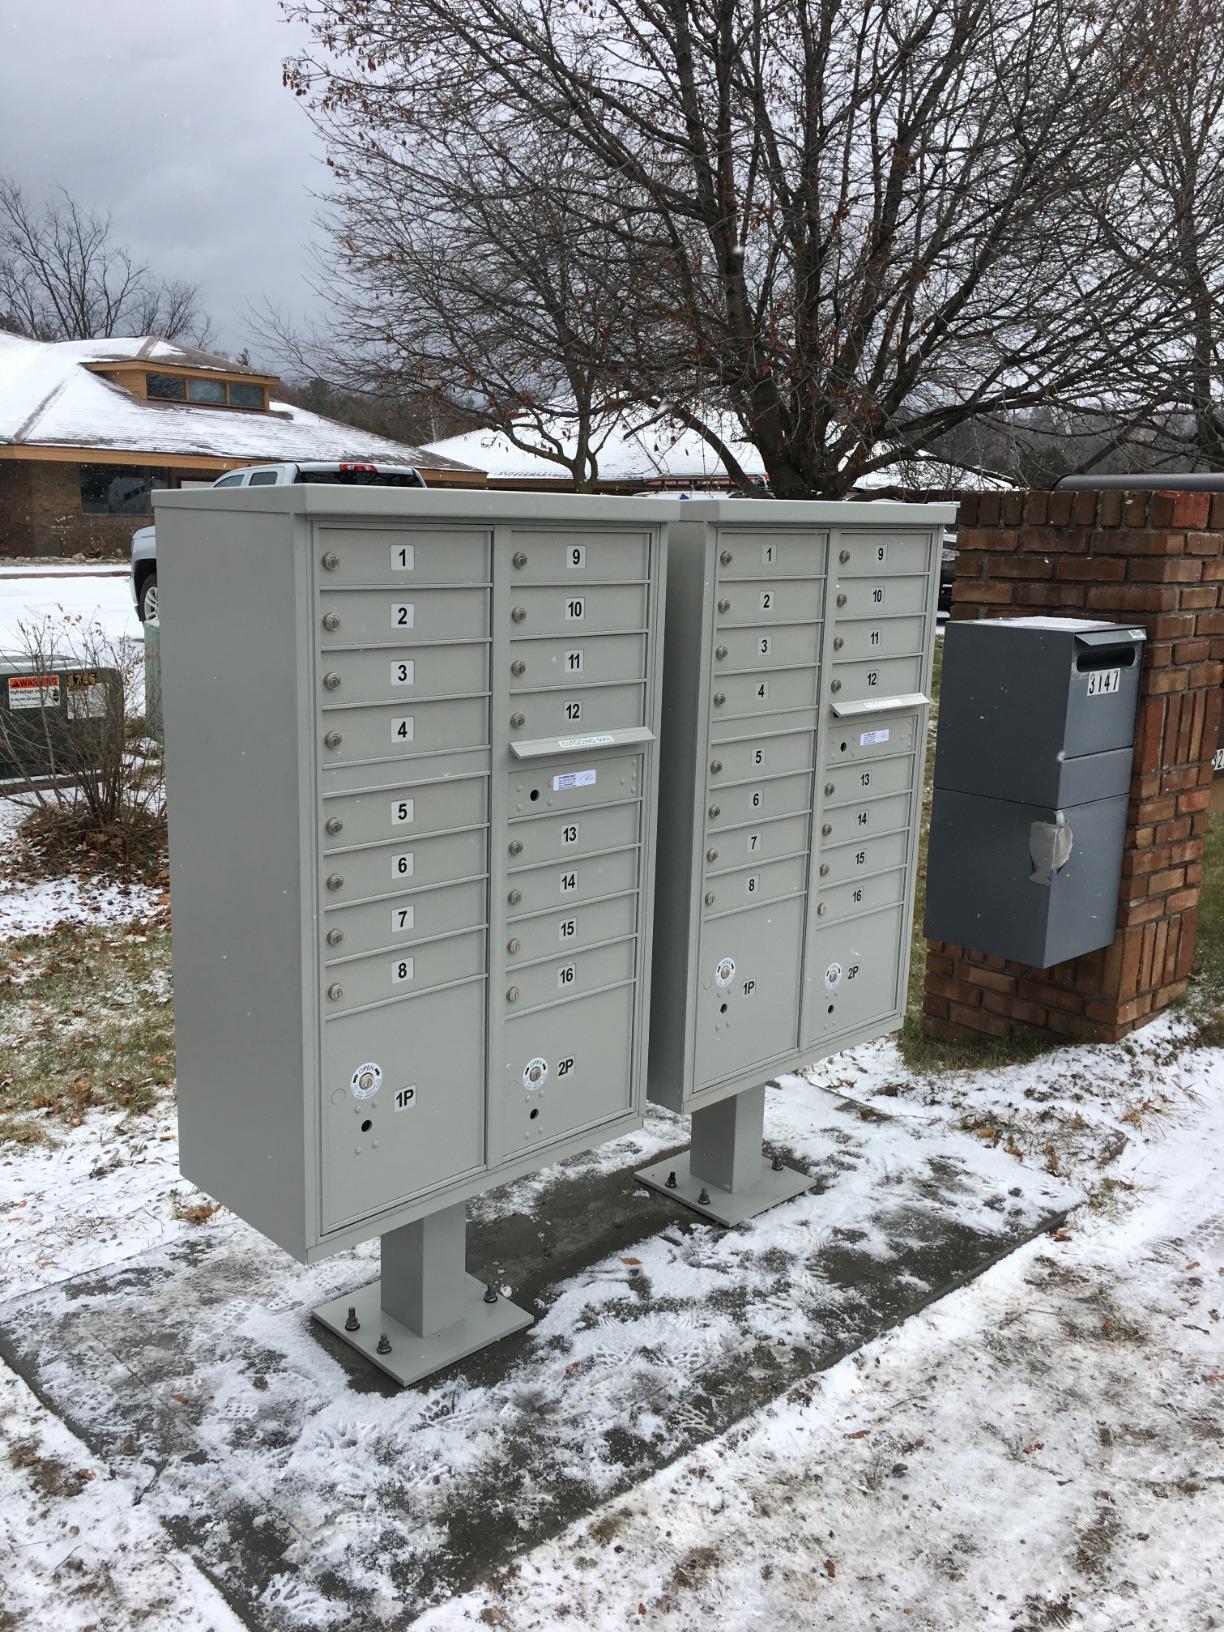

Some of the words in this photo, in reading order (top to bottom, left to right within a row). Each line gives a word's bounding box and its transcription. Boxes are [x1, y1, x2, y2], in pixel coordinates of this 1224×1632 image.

[398, 548, 406, 567] 1
[572, 548, 581, 565] 9
[878, 547, 884, 561] 9
[763, 594, 770, 609] 2
[872, 589, 883, 603] 10
[397, 607, 408, 625] 2
[568, 601, 583, 617] 10
[761, 639, 768, 653] 3
[869, 631, 879, 645] 11
[567, 653, 580, 670] 11
[398, 664, 408, 682] 3
[867, 672, 877, 686] 12
[1088, 671, 1119, 694] 3147
[757, 684, 765, 698] 4
[565, 703, 580, 720] 12
[397, 721, 408, 738] 4
[755, 750, 762, 764] 5
[860, 773, 870, 786] 13
[752, 793, 760, 807] 6
[398, 803, 408, 821] 5
[857, 812, 867, 825] 14
[563, 826, 577, 843] 13
[751, 835, 758, 850] 7
[397, 856, 408, 874] 6
[855, 851, 865, 865] 15
[561, 873, 576, 890] 14
[748, 878, 755, 892] 8
[852, 889, 862, 903] 16
[398, 910, 408, 928] 7
[560, 920, 575, 937] 15
[398, 962, 408, 979] 8
[560, 967, 574, 984] 16
[847, 965, 859, 980] 2P
[743, 980, 755, 995] 1P
[358, 1064, 375, 1074] OPEN
[558, 1058, 574, 1077] 2P
[396, 1088, 414, 1108] 1P
